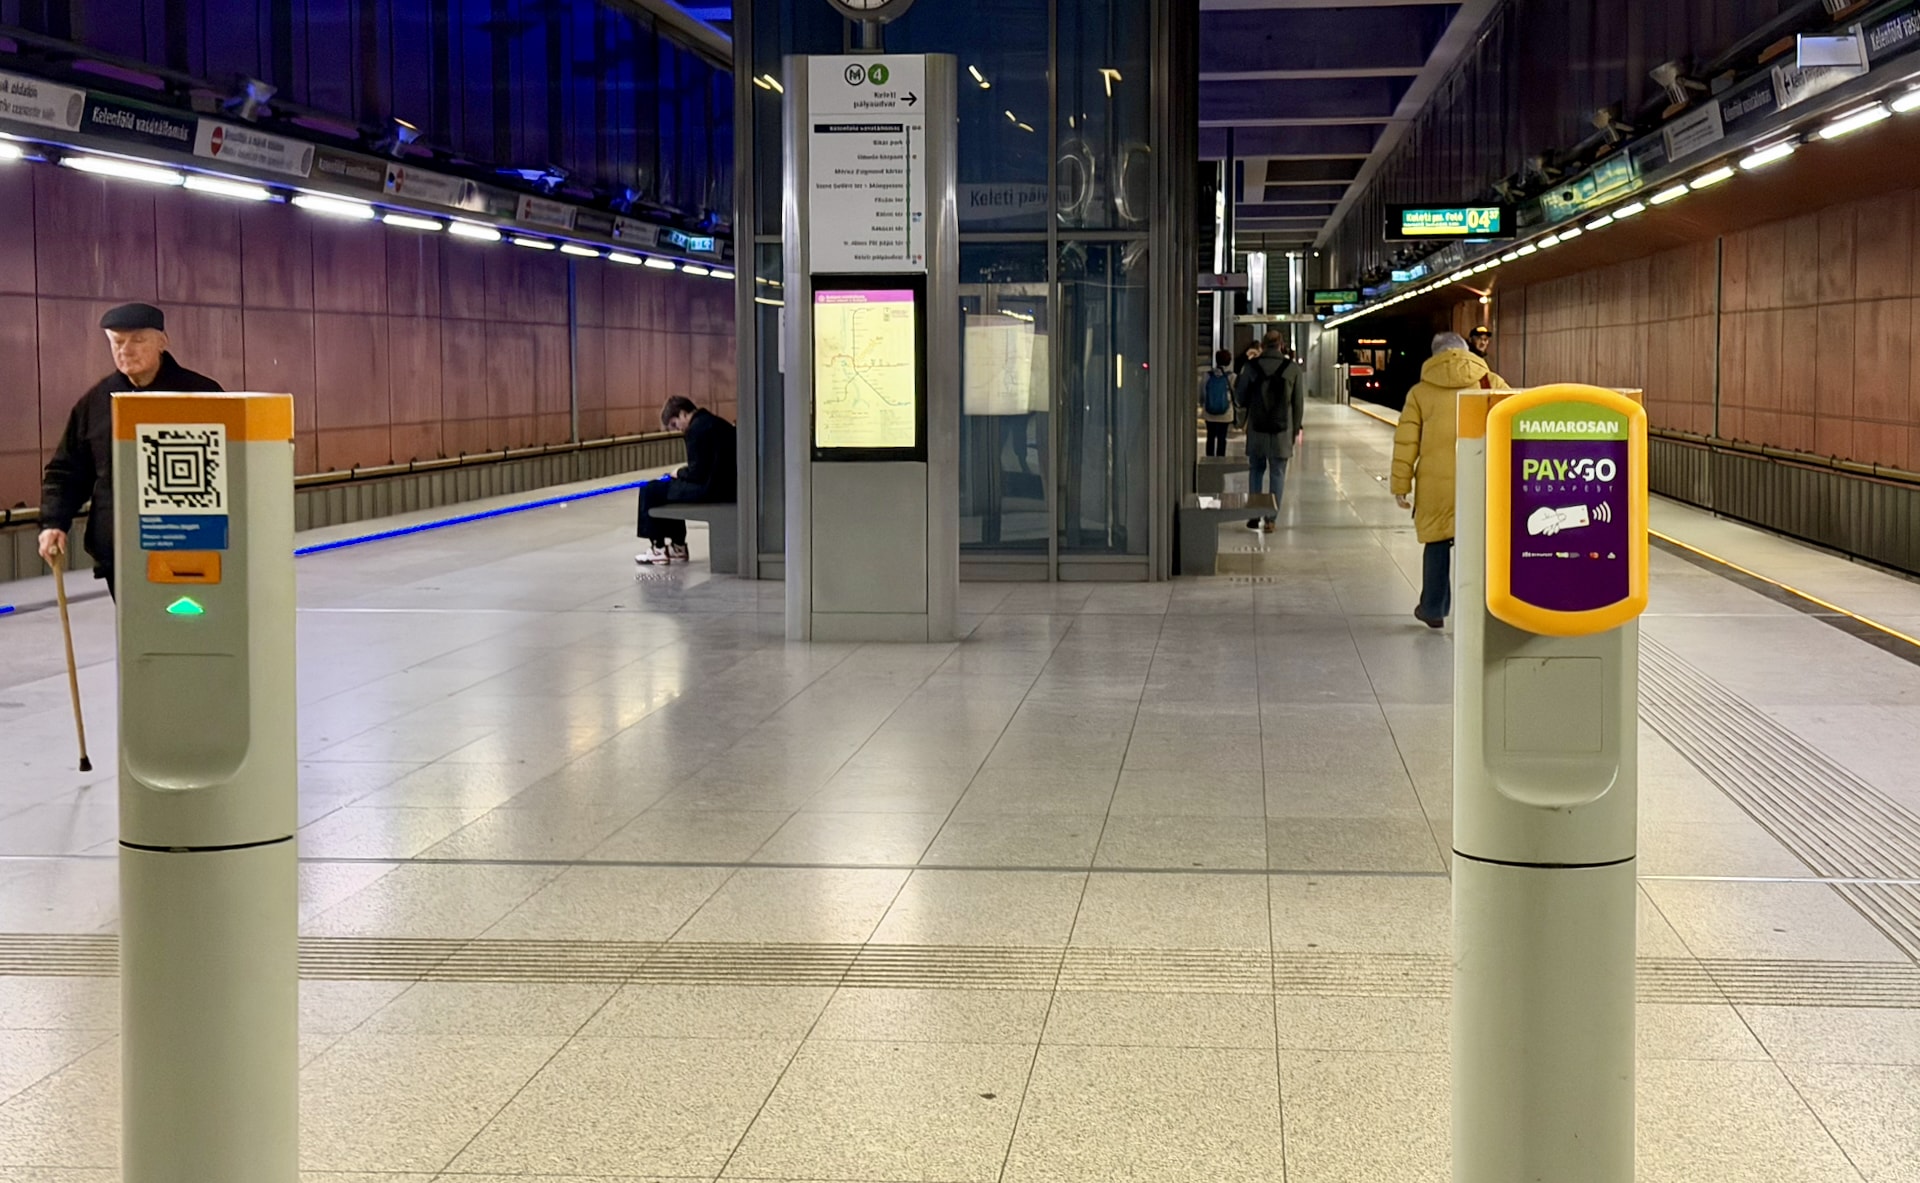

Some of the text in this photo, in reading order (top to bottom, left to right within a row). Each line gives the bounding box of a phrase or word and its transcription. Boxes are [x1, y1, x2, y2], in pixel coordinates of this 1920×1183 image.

[92, 106, 135, 129] Kelenföld
[970, 188, 1013, 208] Keleti
[1468, 210, 1490, 228] 04
[1520, 420, 1619, 433] HAMAROSAN
[1522, 485, 1614, 493] BUDAPEST
